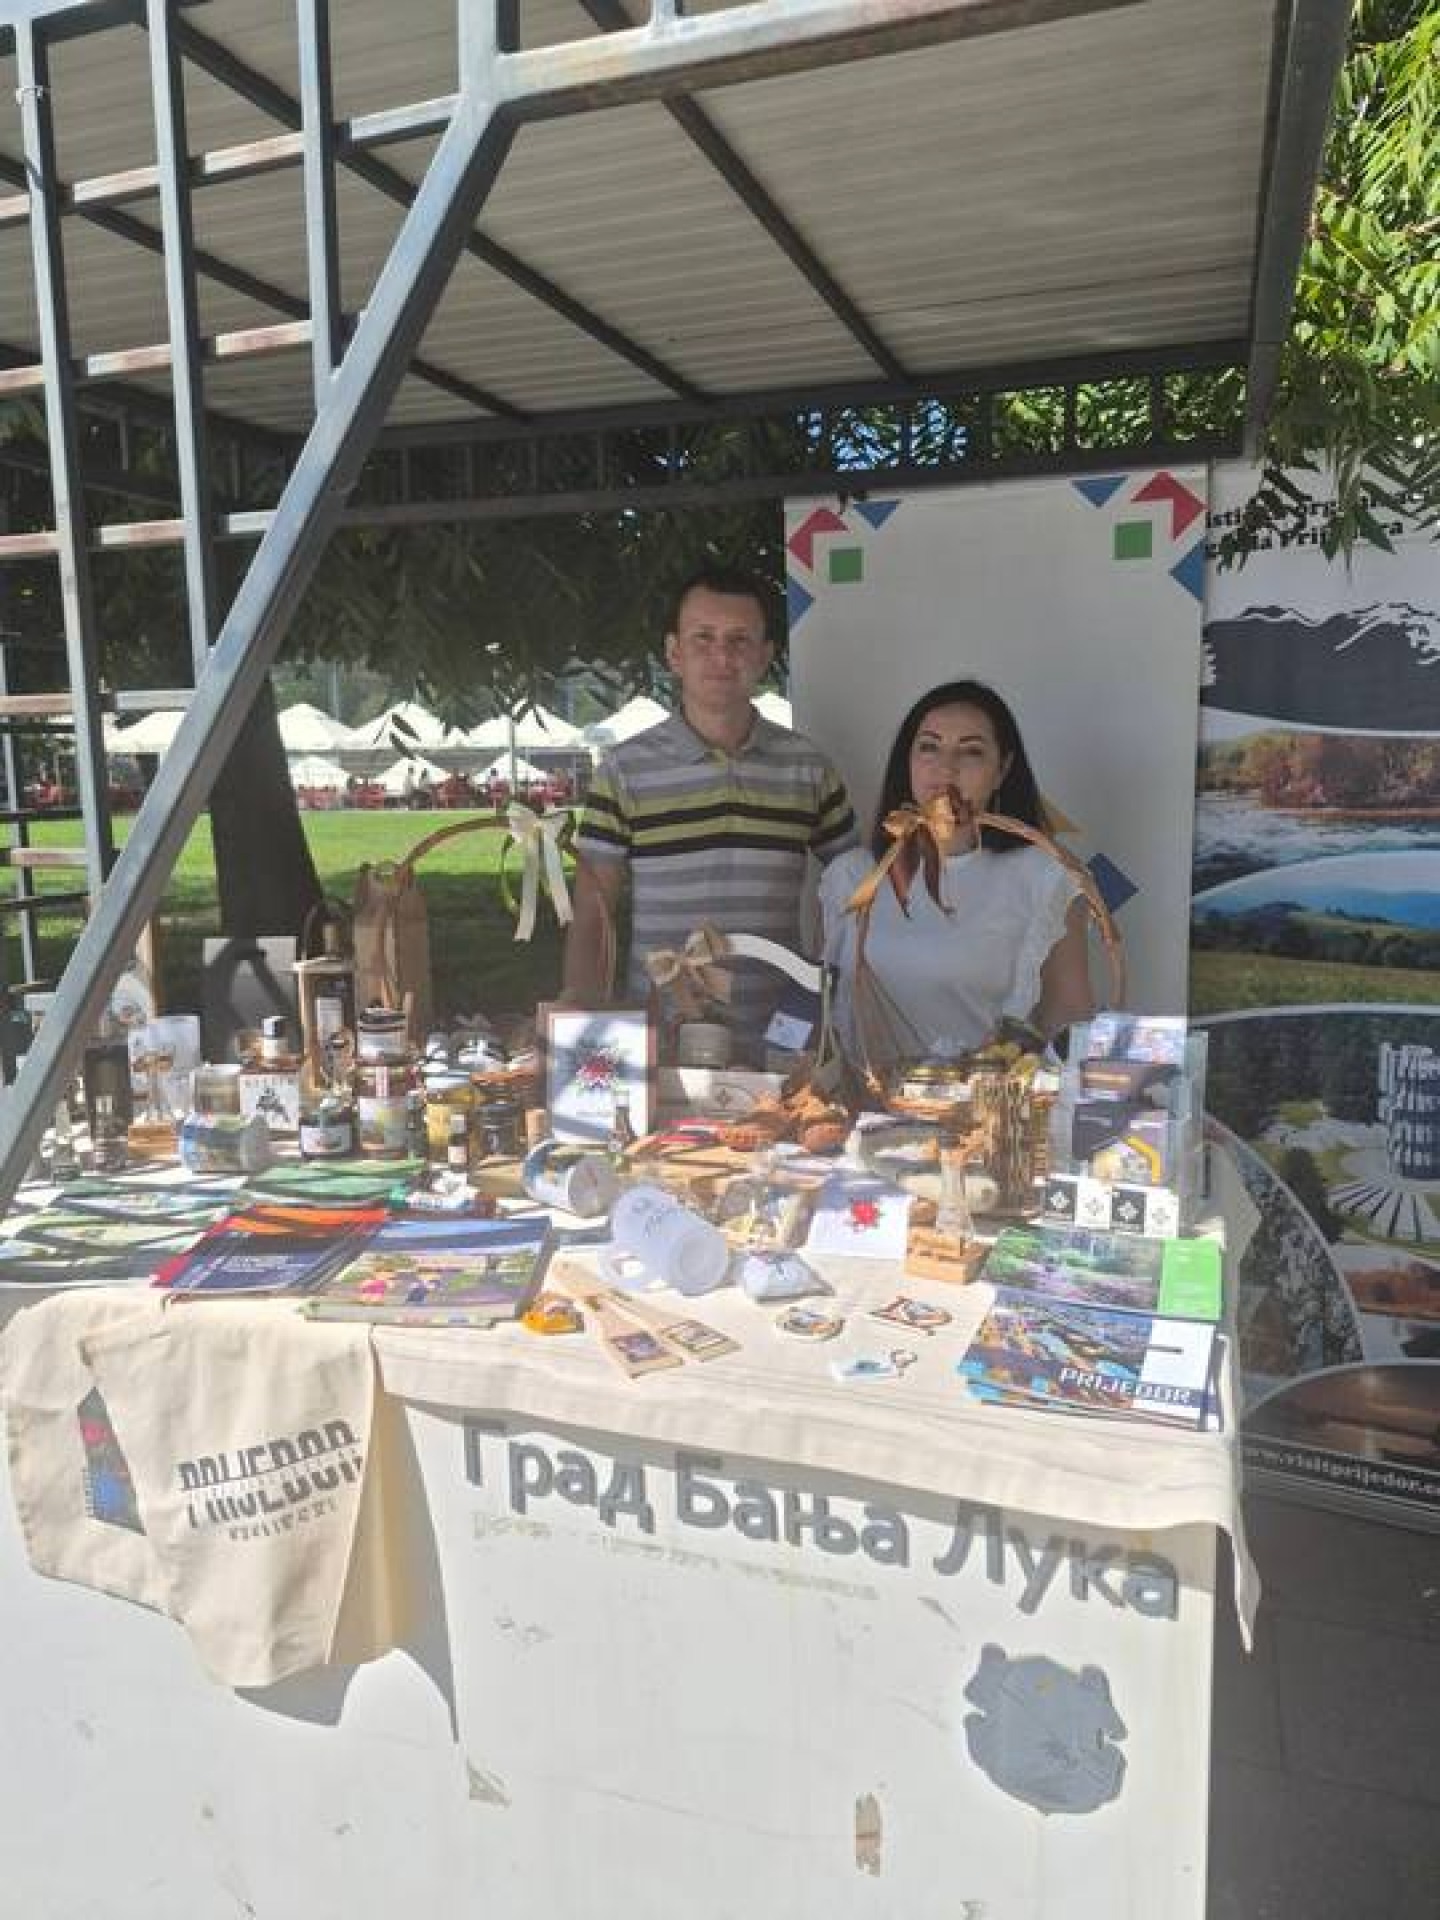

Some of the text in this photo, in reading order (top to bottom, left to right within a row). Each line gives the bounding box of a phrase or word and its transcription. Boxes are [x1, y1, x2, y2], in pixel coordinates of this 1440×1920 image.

[462, 1423, 655, 1534] Град
[676, 1455, 908, 1568] Бања
[934, 1498, 1180, 1622] Лука
